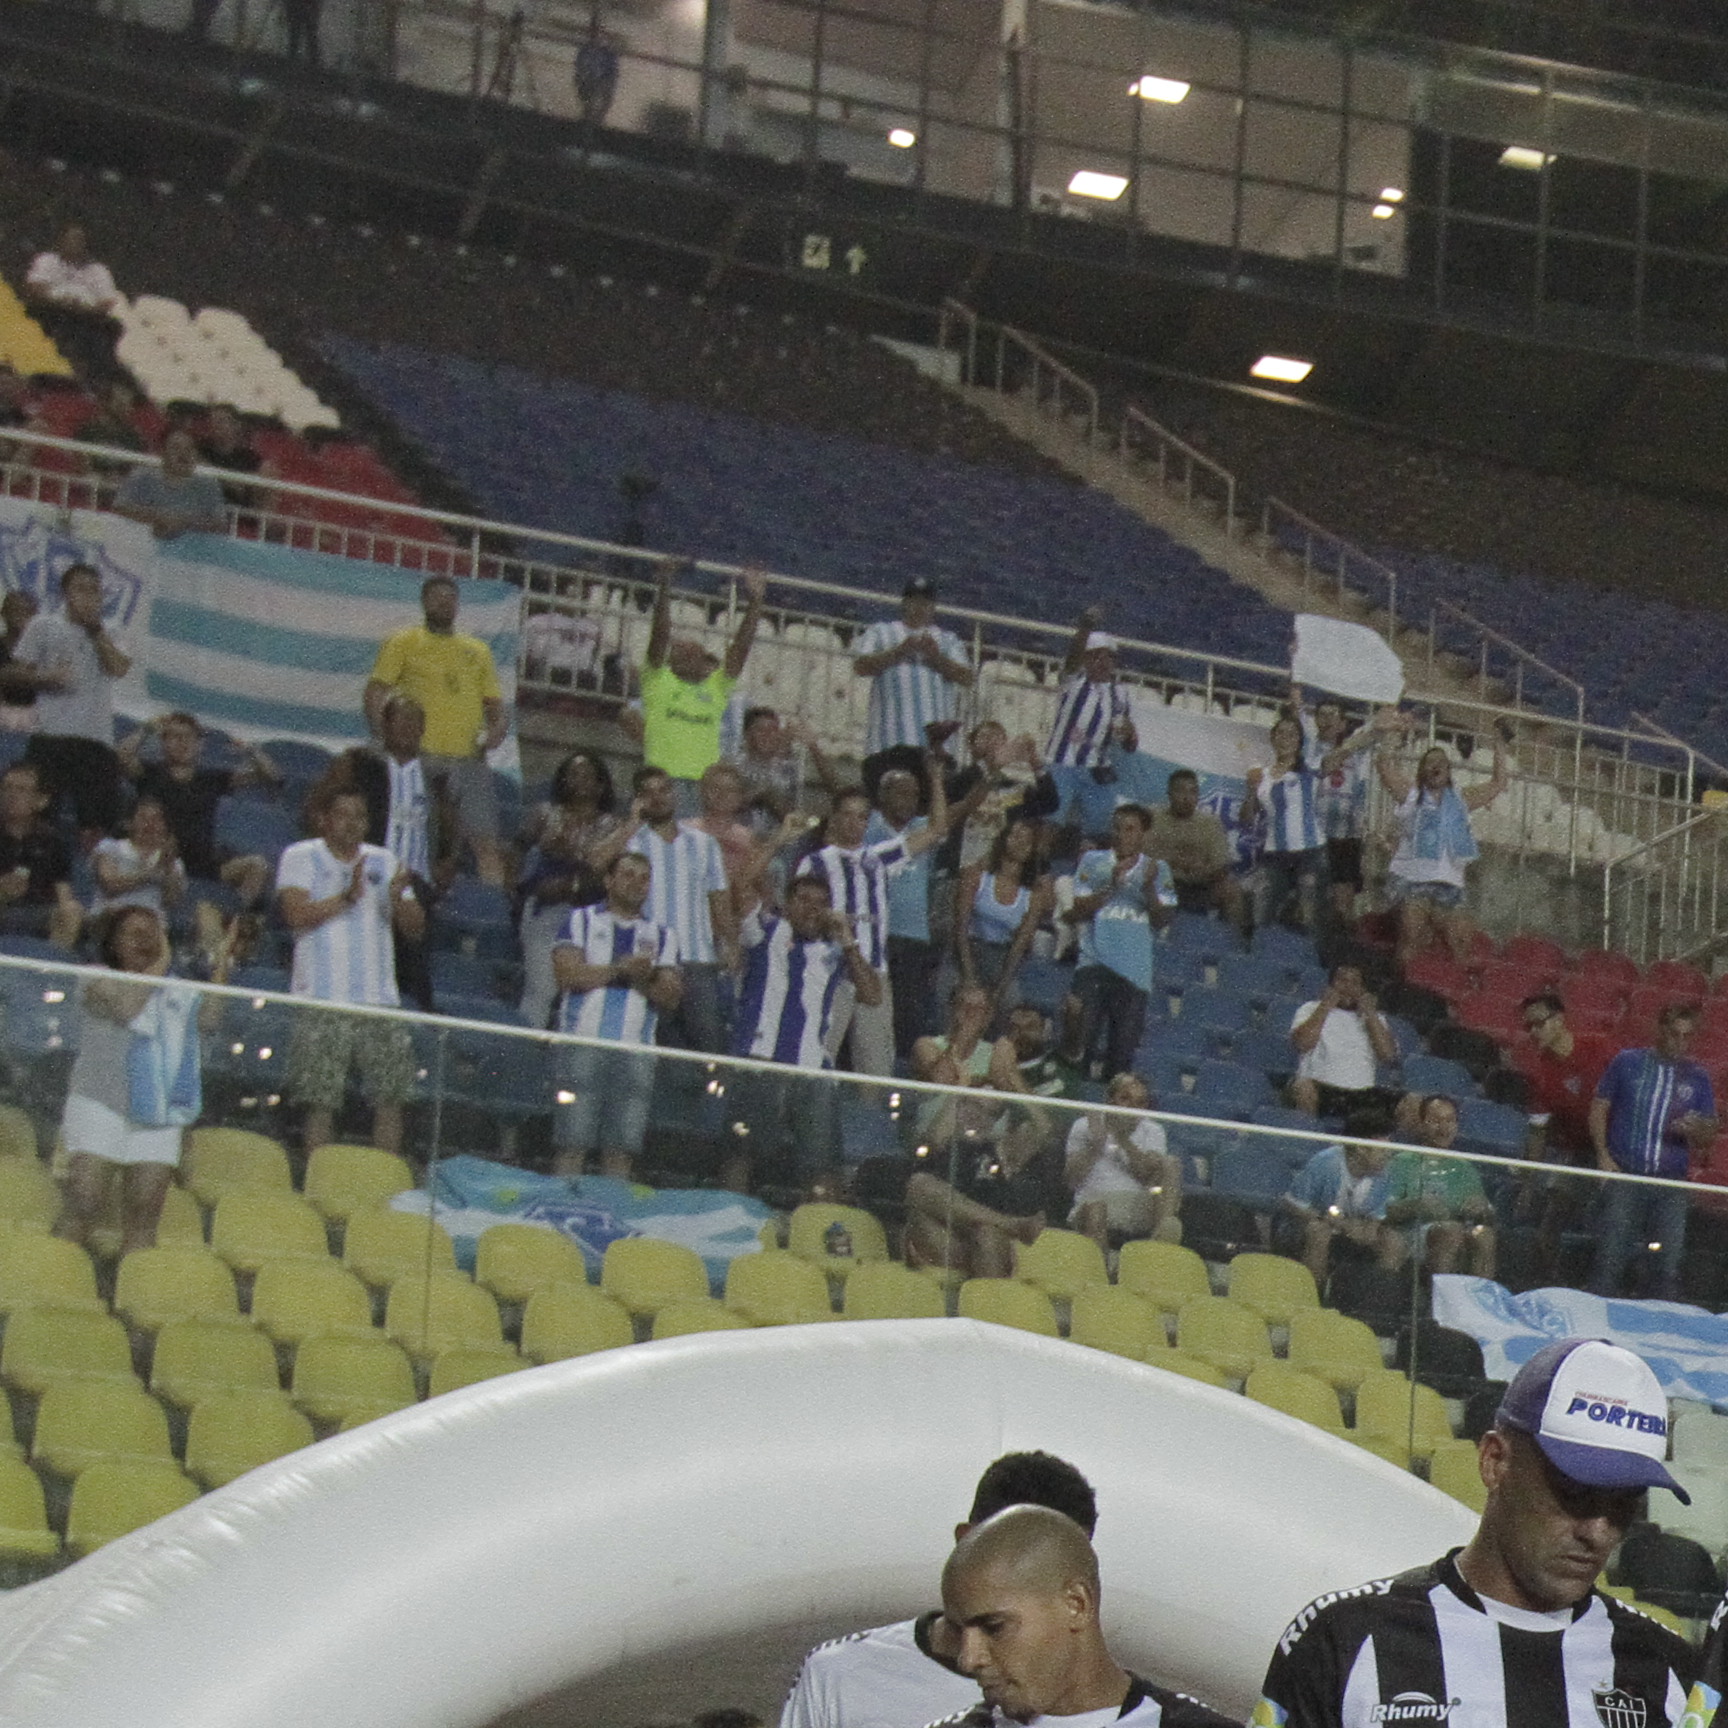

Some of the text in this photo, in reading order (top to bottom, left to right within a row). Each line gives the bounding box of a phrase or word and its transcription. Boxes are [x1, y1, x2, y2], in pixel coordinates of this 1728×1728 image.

[1281, 1579, 1394, 1656] Rhumy
[1370, 1702, 1452, 1723] Rhumy
[1604, 1696, 1635, 1712] CAI
